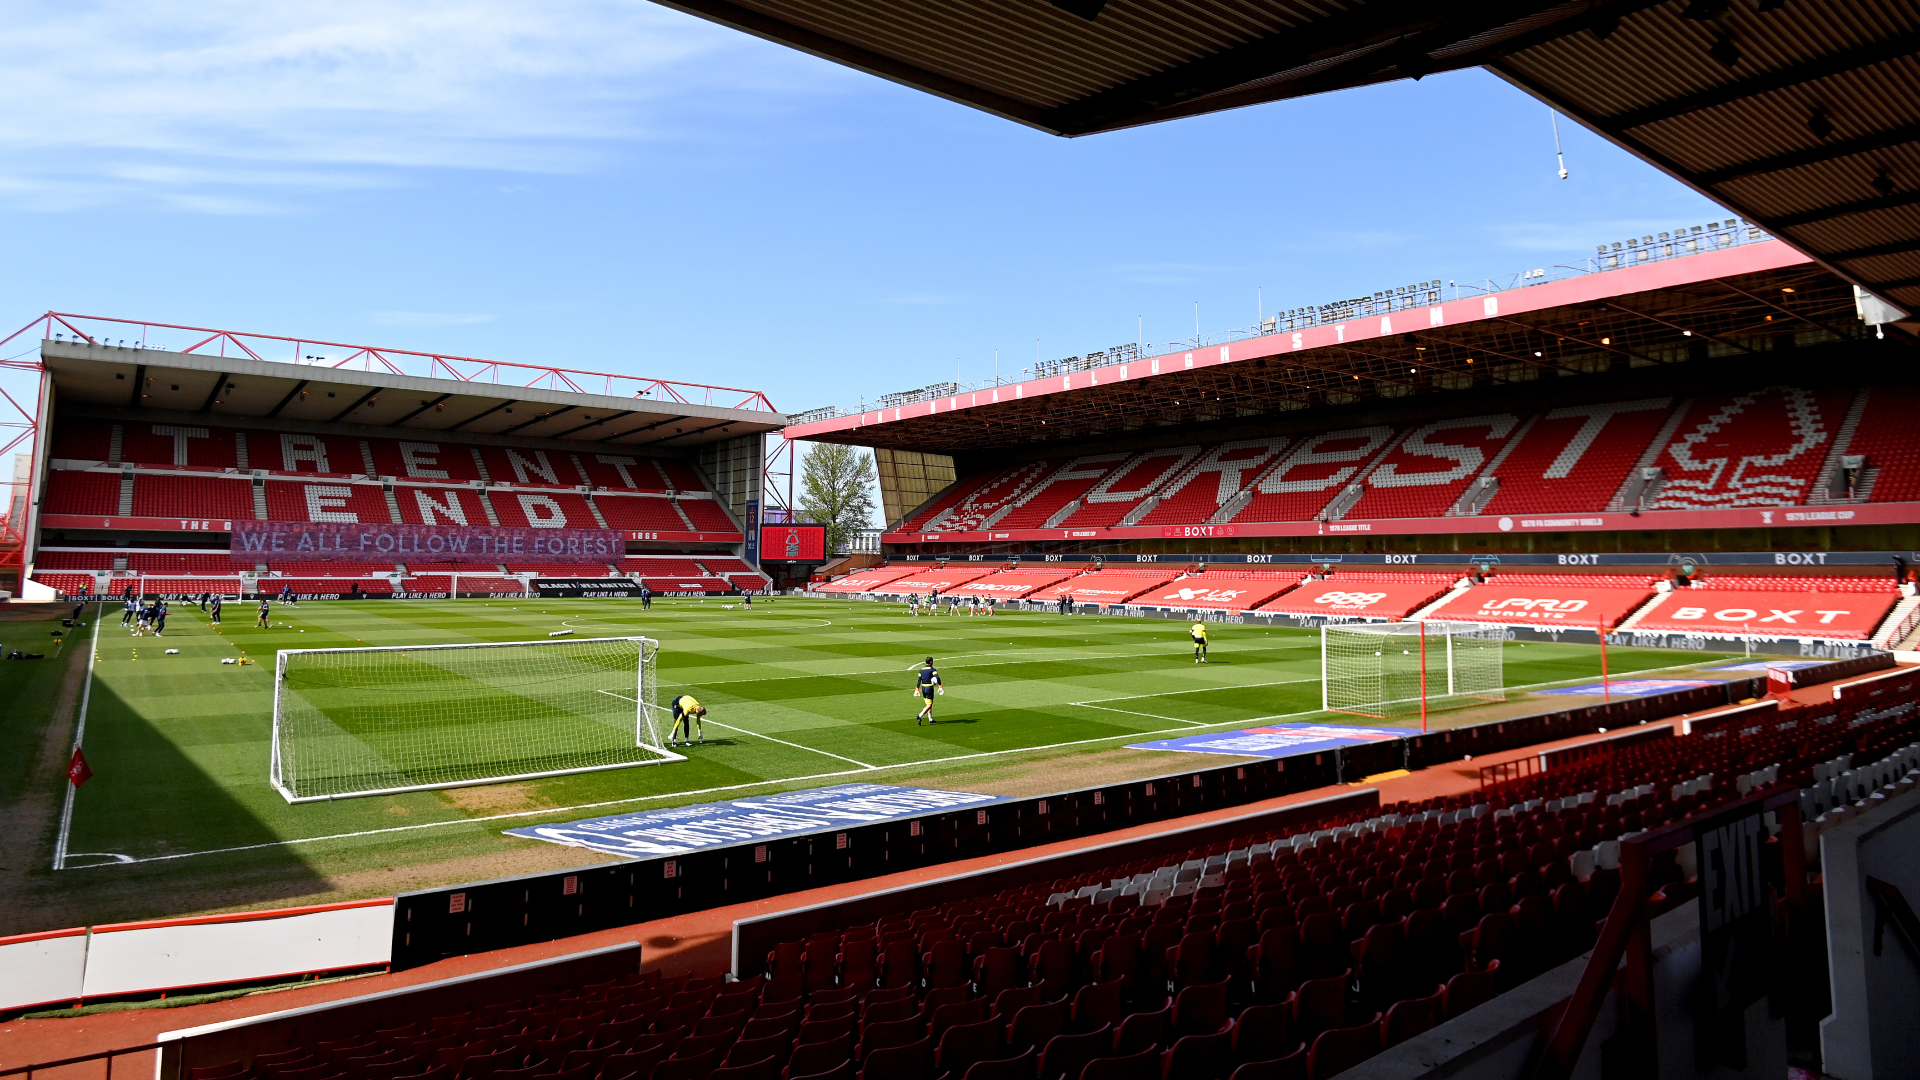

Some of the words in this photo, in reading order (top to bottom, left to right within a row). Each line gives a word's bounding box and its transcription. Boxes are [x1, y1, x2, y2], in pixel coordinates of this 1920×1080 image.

[1063, 346, 1229, 391] CLOUGH
[1292, 297, 1498, 349] STAND
[152, 425, 637, 489] TRENT
[304, 484, 568, 529] END
[181, 520, 209, 530] THE
[632, 532, 658, 540] 1865
[1184, 526, 1215, 537] BOXT
[241, 532, 286, 551] WE
[297, 532, 349, 551] ALL
[360, 533, 470, 553] FOLLOW
[478, 535, 524, 555] THE
[534, 537, 620, 555] FOREST
[1136, 555, 1158, 563] BOXT
[1246, 555, 1273, 563] BOXT
[1385, 554, 1418, 564] BOXT
[1558, 554, 1599, 565] BOXT
[1774, 553, 1828, 565] BOXT
[1019, 604, 1031, 612] PLAY
[1098, 607, 1112, 616] PLAY
[1112, 608, 1124, 616] LIKE
[1129, 609, 1145, 617] HERO
[1187, 613, 1203, 621] PLAY
[1204, 614, 1218, 622] LIKE
[1225, 616, 1244, 624] HERO
[1670, 607, 1851, 624] BOXT
[1300, 619, 1318, 628] PLAY
[1604, 634, 1629, 646] PLAY
[1631, 635, 1657, 648] LIKE
[1659, 637, 1668, 648] A
[1671, 637, 1706, 650] HERO
[1800, 644, 1830, 658] PLAY
[1833, 645, 1859, 660] LIKE
[1702, 812, 1762, 933] EXIT
